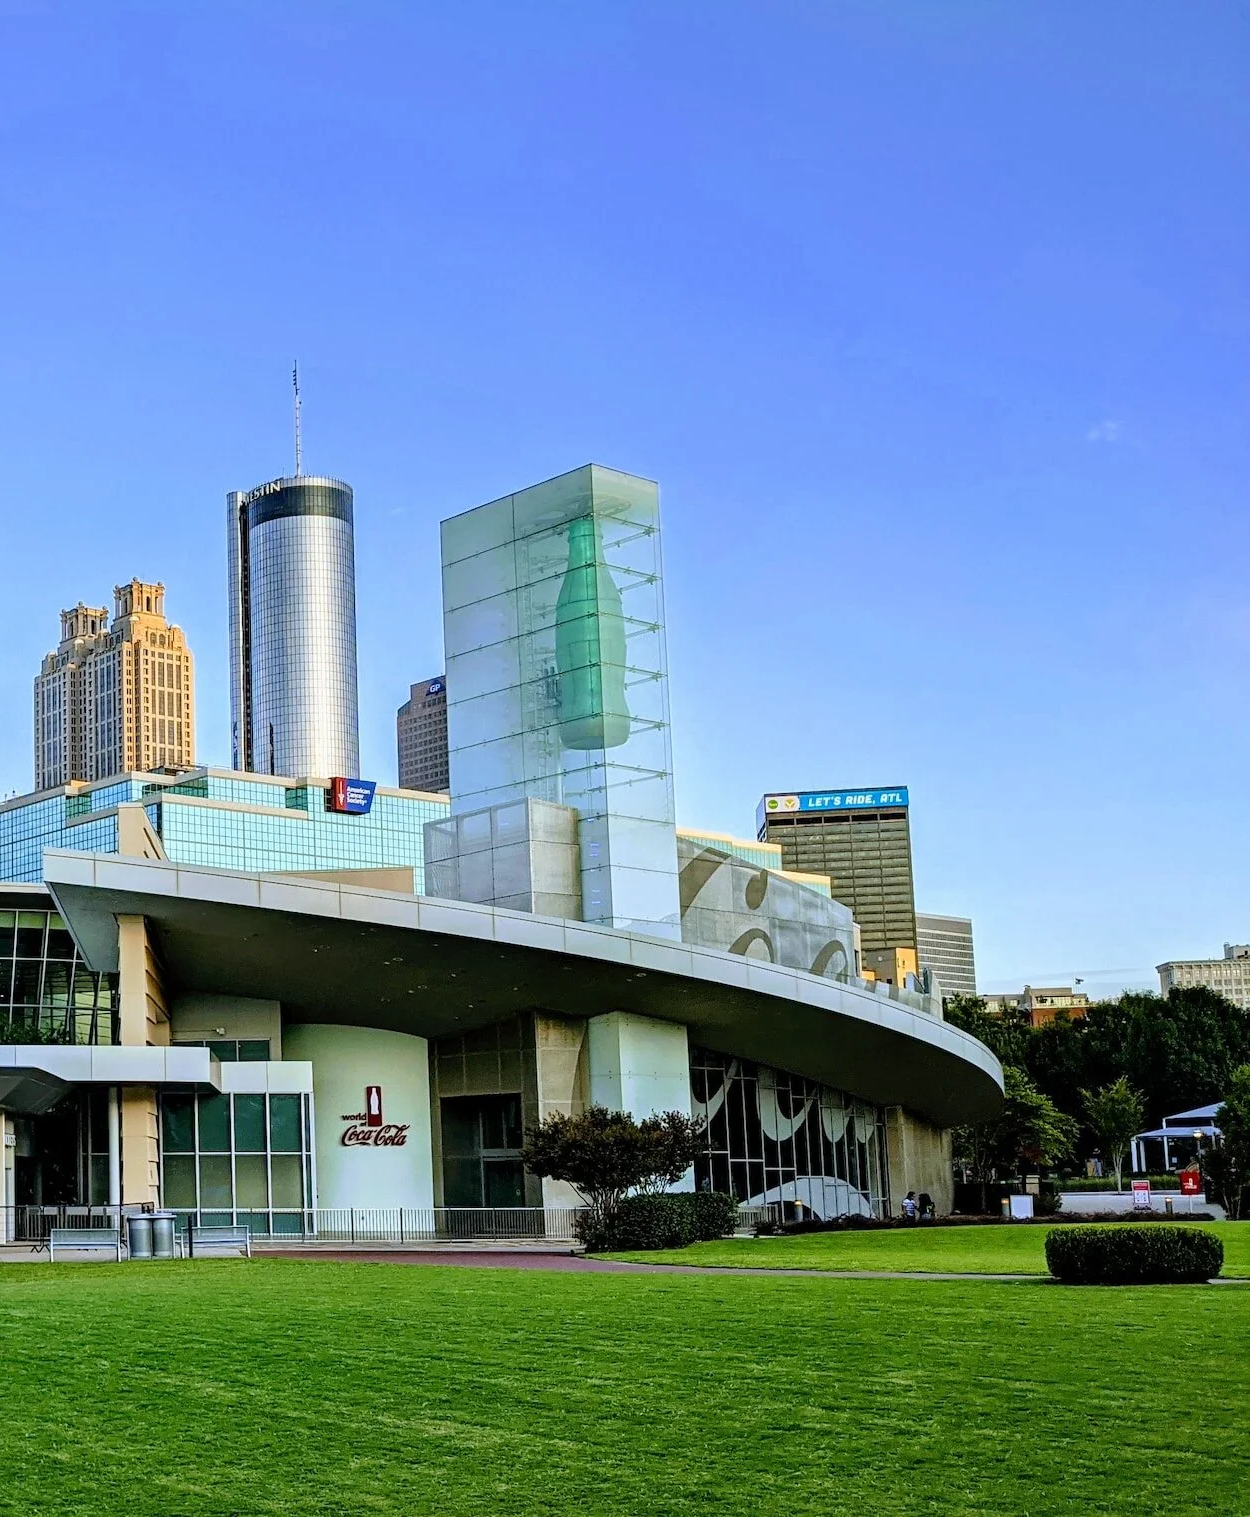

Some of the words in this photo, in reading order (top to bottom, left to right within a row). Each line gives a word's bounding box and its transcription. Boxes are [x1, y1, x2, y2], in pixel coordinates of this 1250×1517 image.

[240, 480, 281, 506] WESTIN
[430, 684, 441, 692] GP
[808, 796, 842, 807] LET'S
[845, 794, 876, 805] RIDE,
[880, 793, 903, 803] ATL
[341, 1112, 367, 1121] world
[341, 1124, 410, 1146] Coca-Cola
